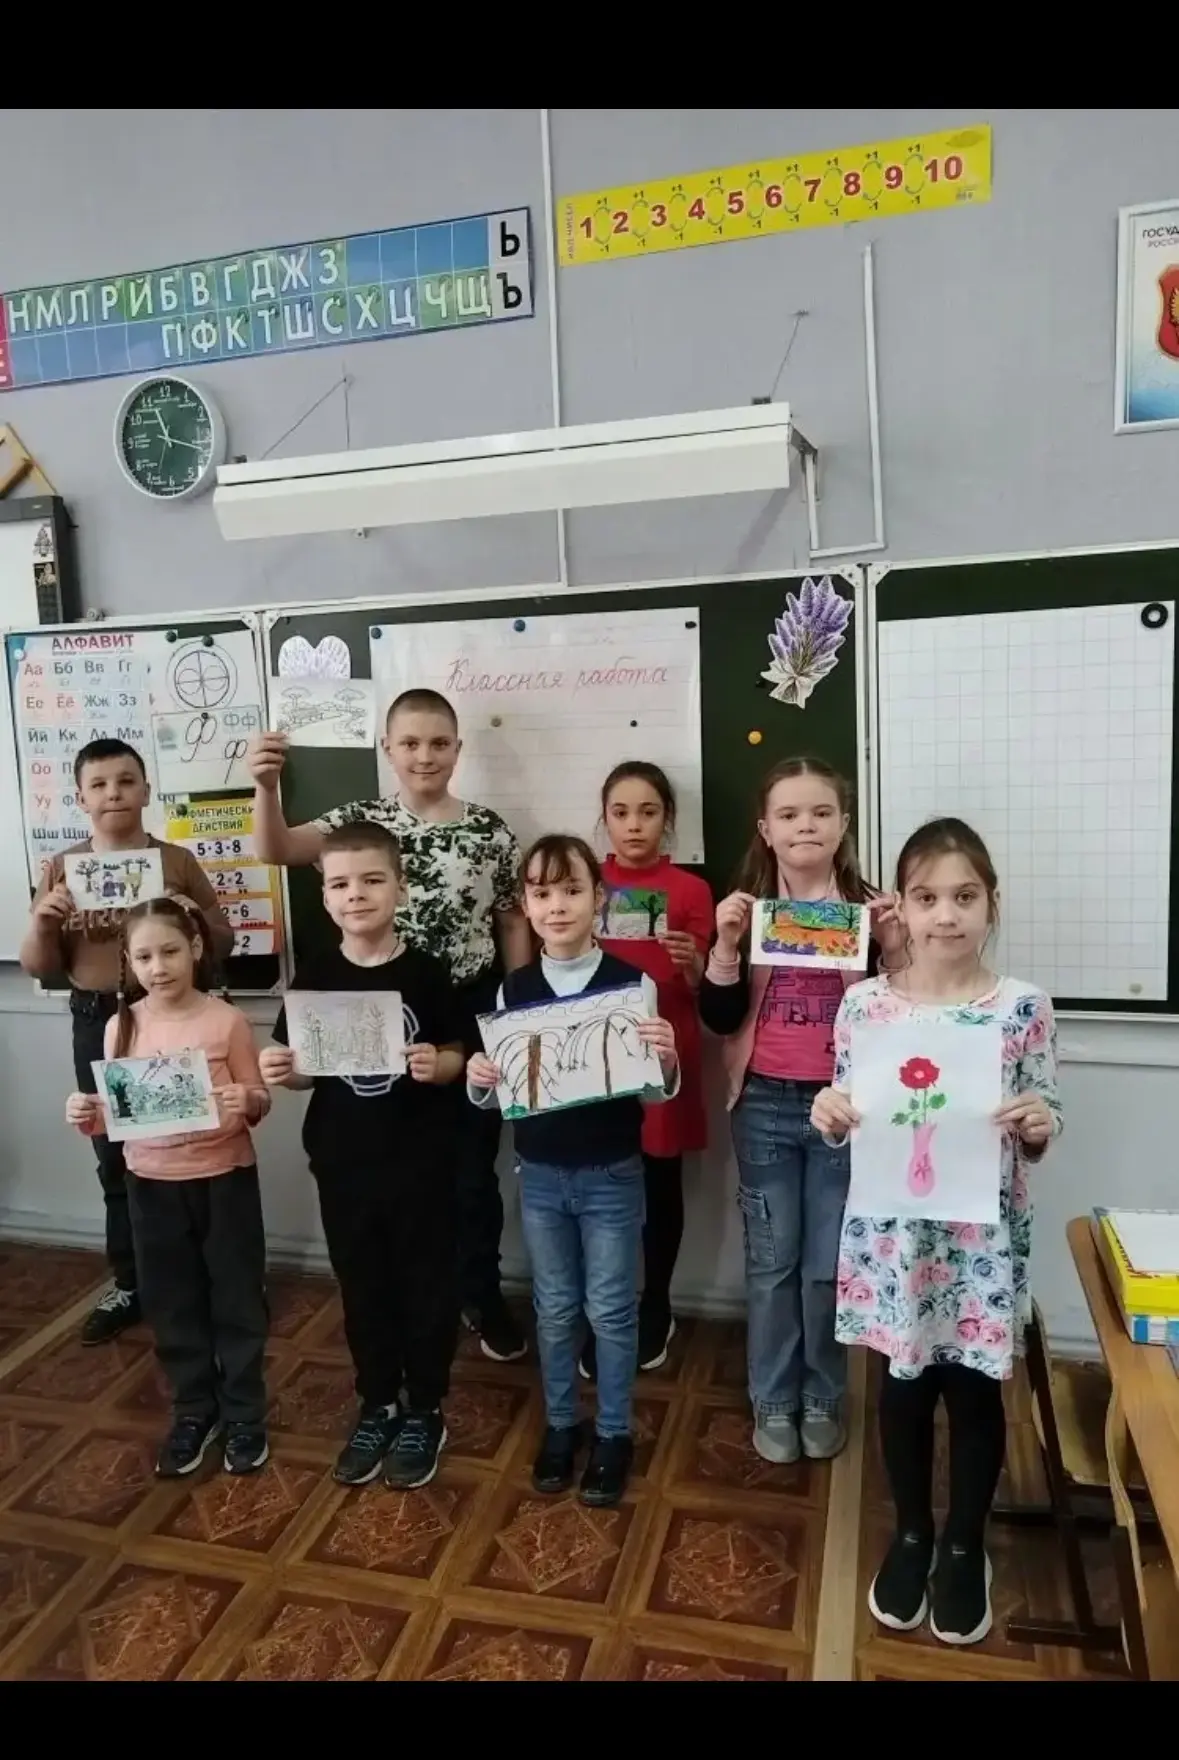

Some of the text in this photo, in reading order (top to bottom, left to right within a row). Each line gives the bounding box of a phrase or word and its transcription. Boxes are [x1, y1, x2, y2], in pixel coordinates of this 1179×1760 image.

[580, 155, 963, 239] 1 2 3 4 5 6 7 8 9 10
[8, 221, 521, 333] Н М Л Р Й Б В Г Д Ж З Ь
[162, 272, 523, 358] П Ф К Т Ш С Х Ц Ч Щ Ъ
[52, 634, 134, 650] АЛФАВИТ
[24, 660, 132, 676] Аа Бб Вв Гг
[447, 656, 669, 700] Классная работа
[84, 694, 110, 707] Жж
[119, 694, 137, 706] Зз
[60, 728, 78, 740] Кк
